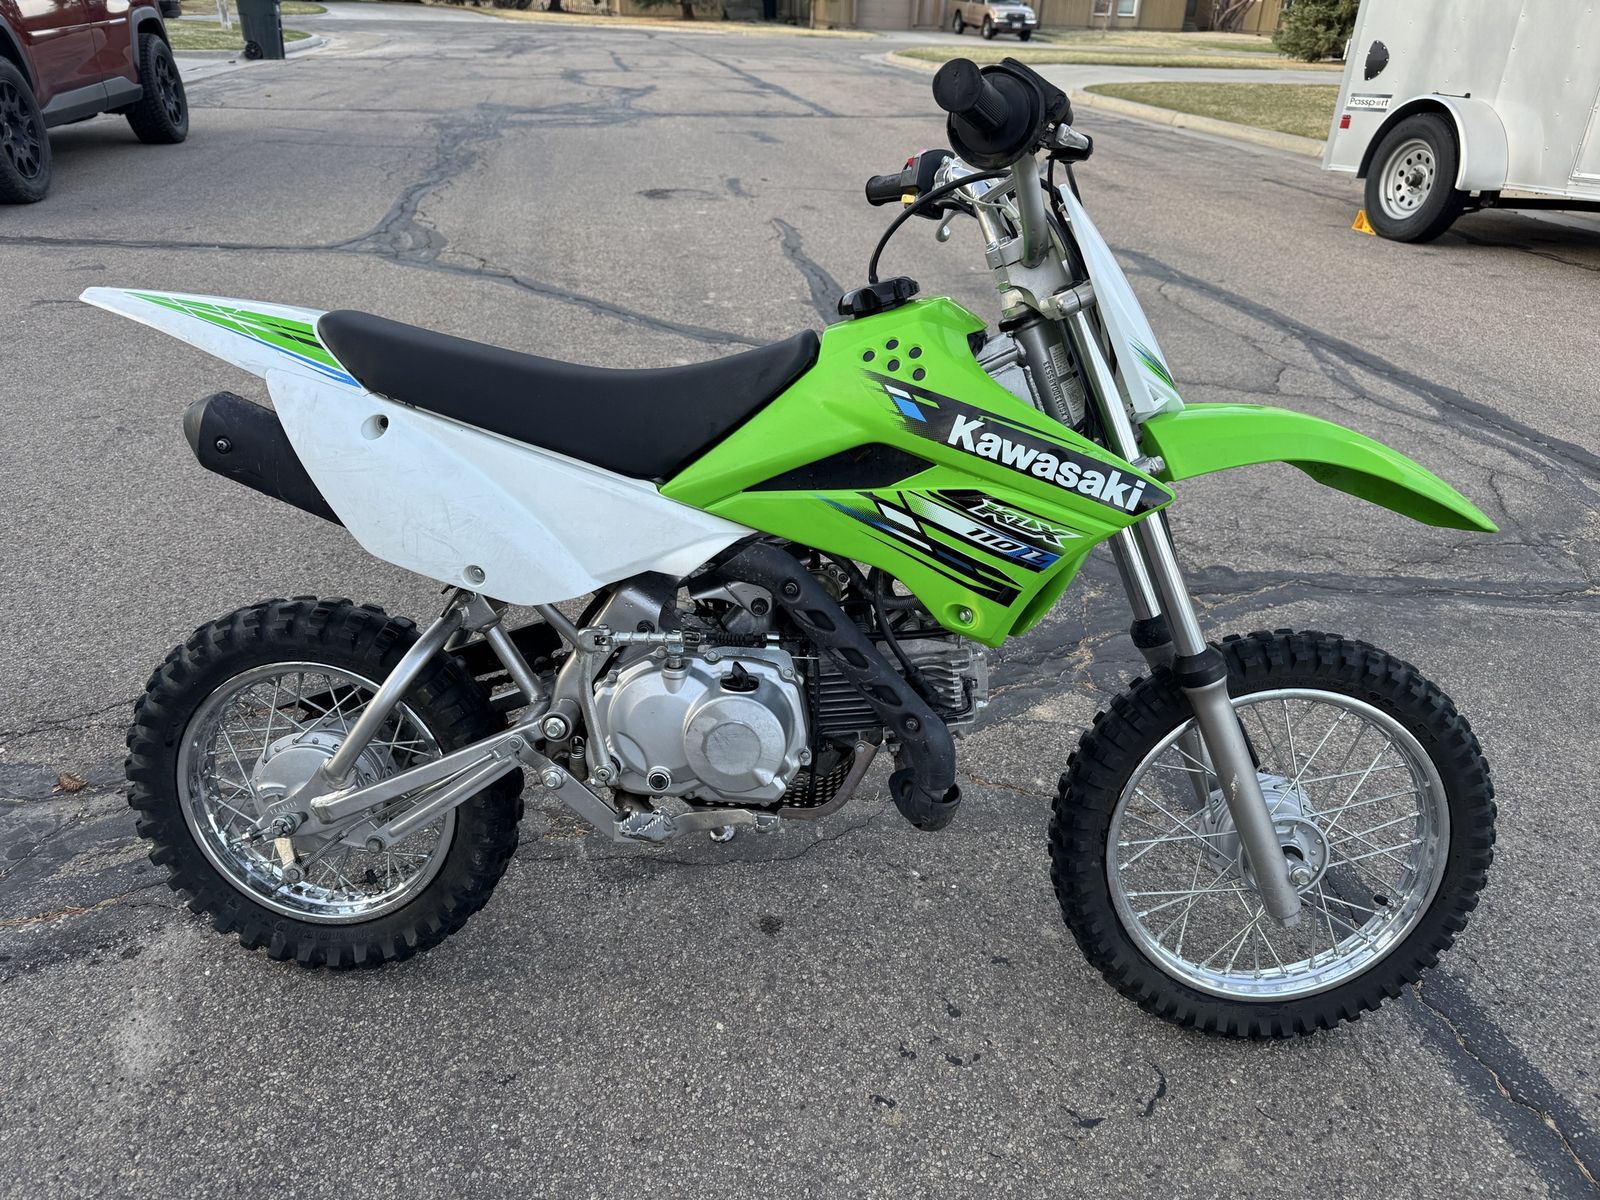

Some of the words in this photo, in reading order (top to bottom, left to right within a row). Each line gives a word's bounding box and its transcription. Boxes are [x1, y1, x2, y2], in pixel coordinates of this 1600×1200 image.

[1350, 97, 1389, 107] Passport
[947, 414, 1147, 512] Kawasaki
[967, 498, 1083, 549] KLX
